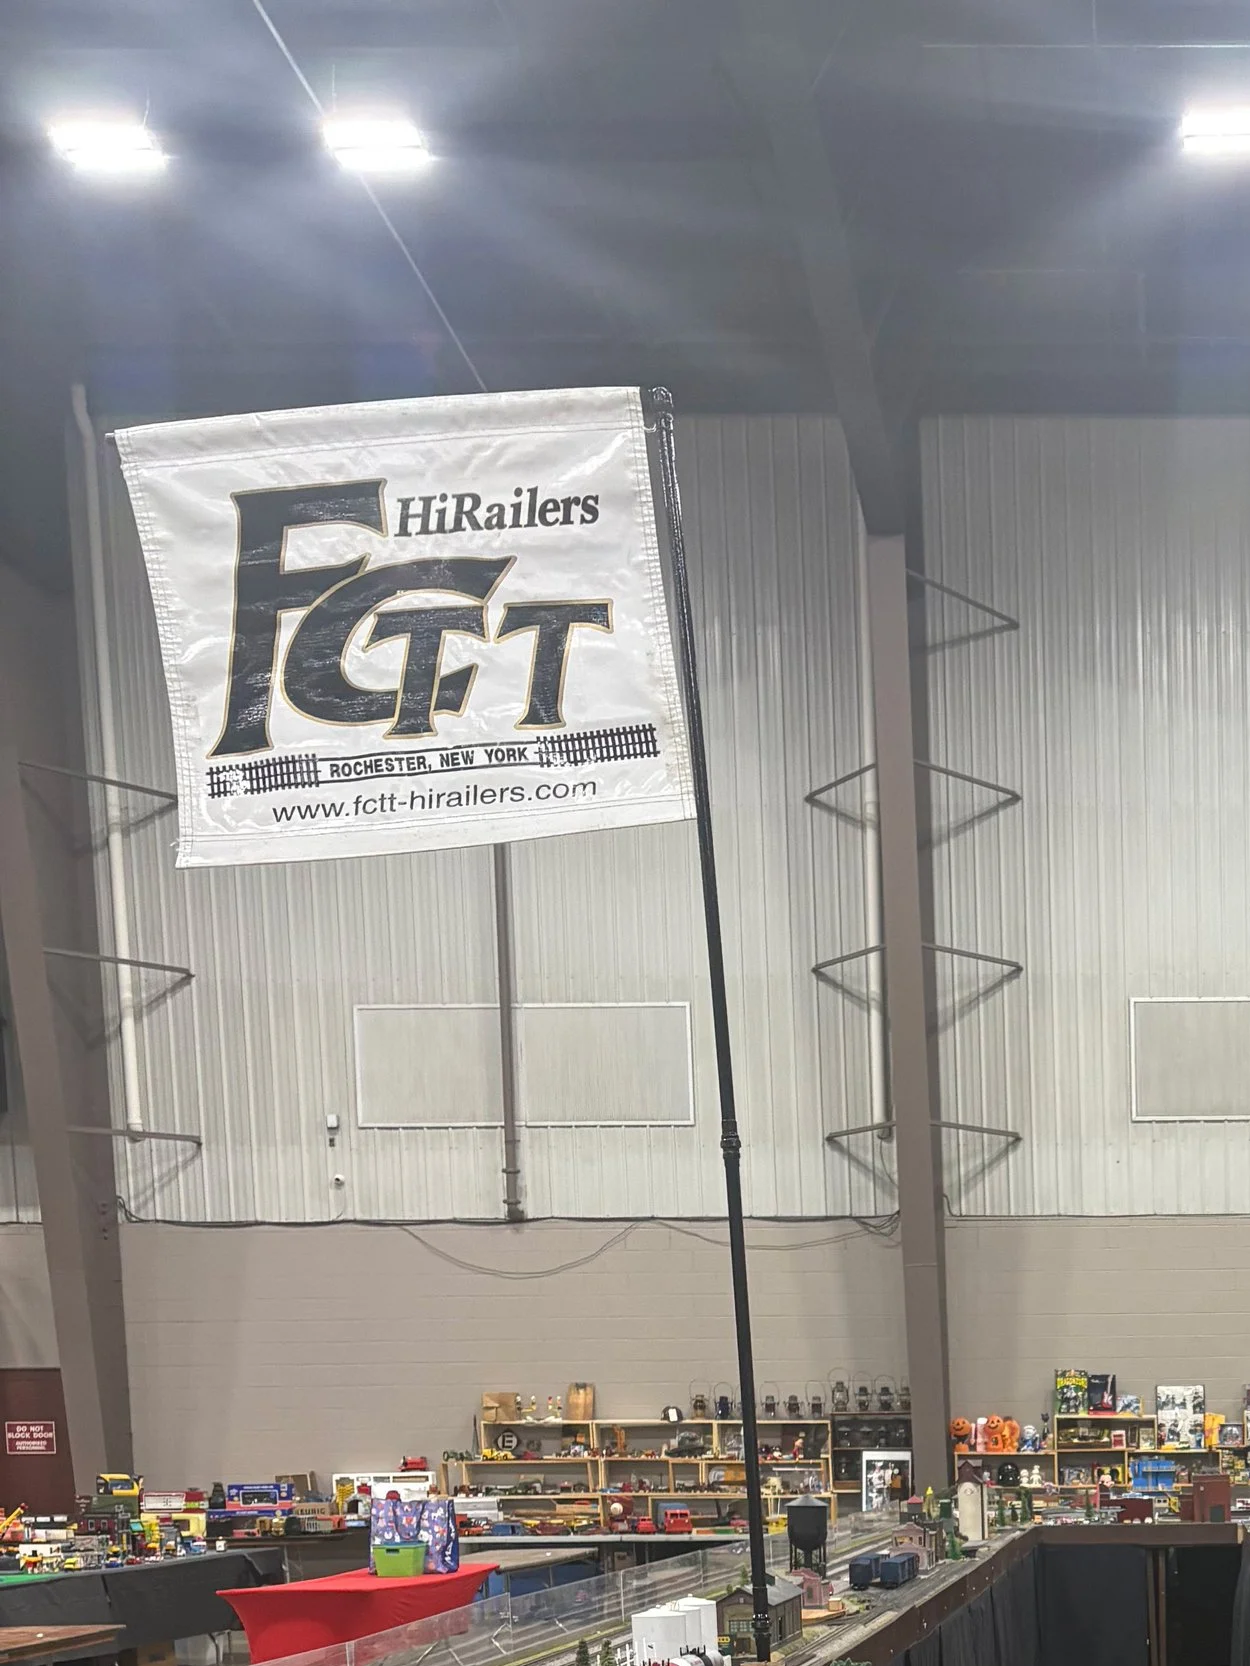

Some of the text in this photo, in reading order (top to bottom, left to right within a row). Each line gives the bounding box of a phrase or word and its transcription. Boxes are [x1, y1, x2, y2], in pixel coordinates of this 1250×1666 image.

[394, 486, 600, 537] HiRailers
[329, 746, 529, 779] ROCHESTER, NEW YORK
[272, 780, 597, 824] www.fctt-hirailers.com
